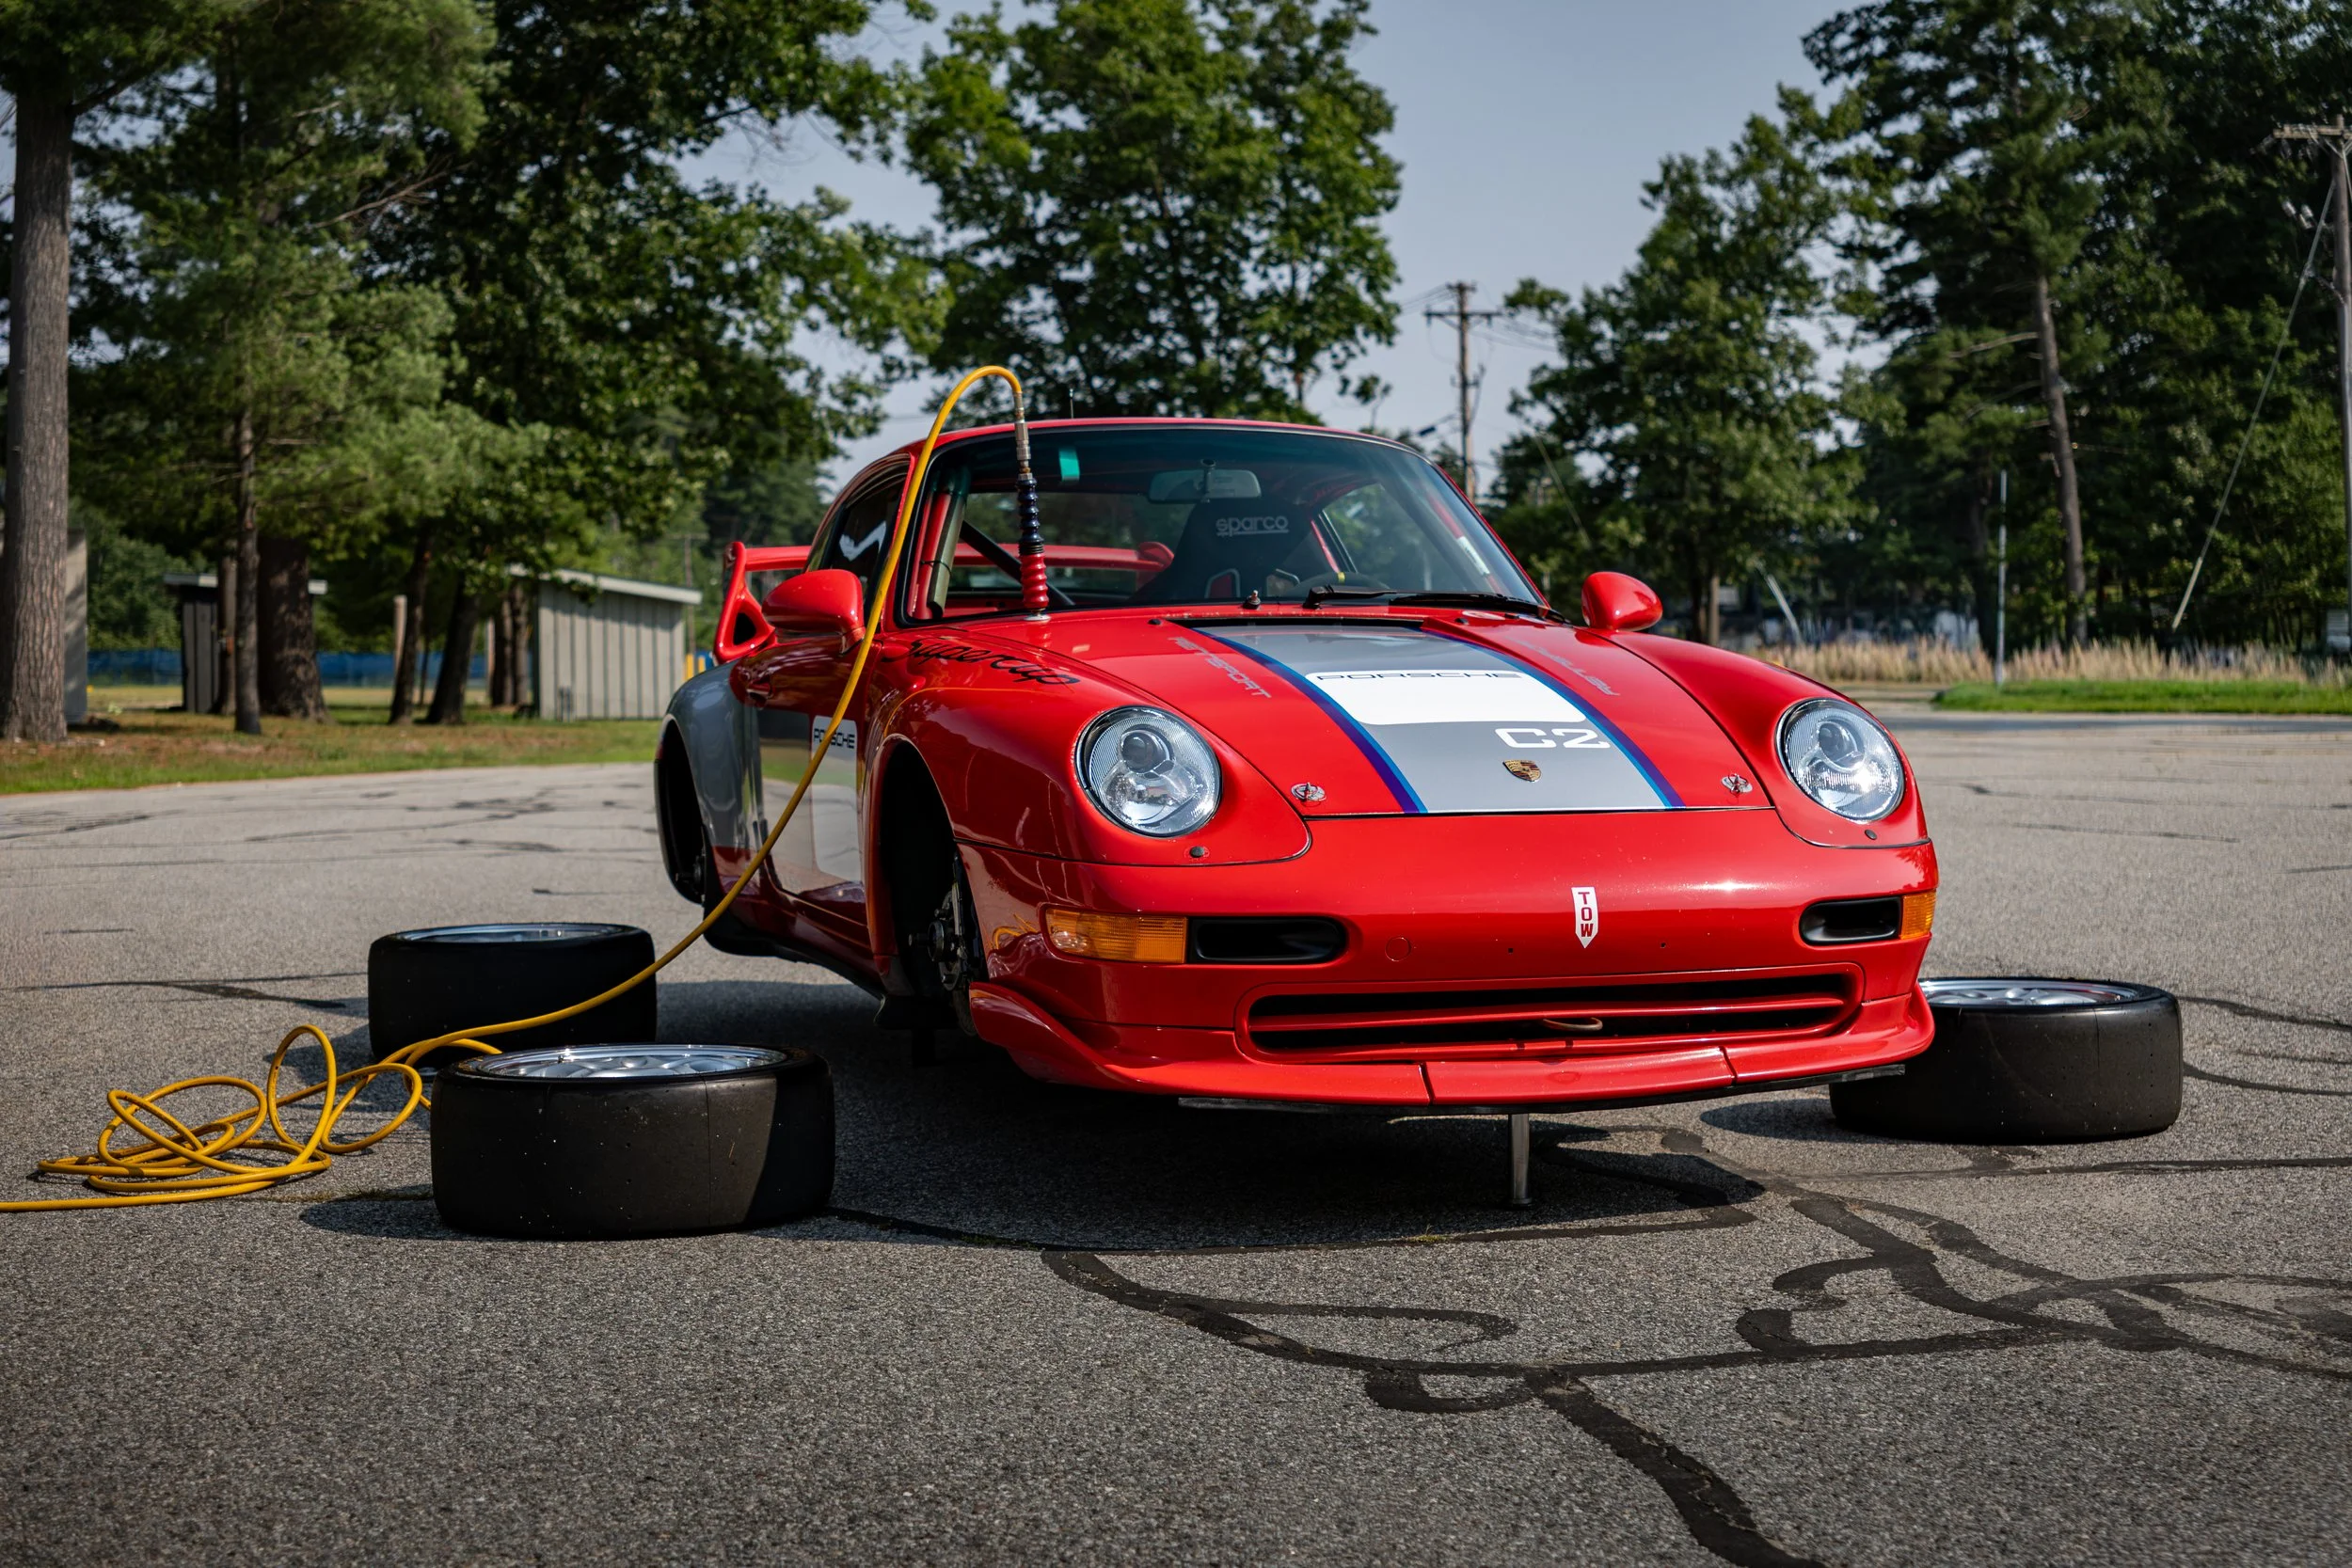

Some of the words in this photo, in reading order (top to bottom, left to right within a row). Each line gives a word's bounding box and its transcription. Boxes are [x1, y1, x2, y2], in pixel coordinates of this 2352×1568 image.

[1215, 515, 1289, 537] sparco
[1317, 672, 1522, 681] PORSCHE
[813, 728, 855, 750] POSCHE
[1494, 727, 1611, 749] C2
[1577, 891, 1595, 938] TOW
